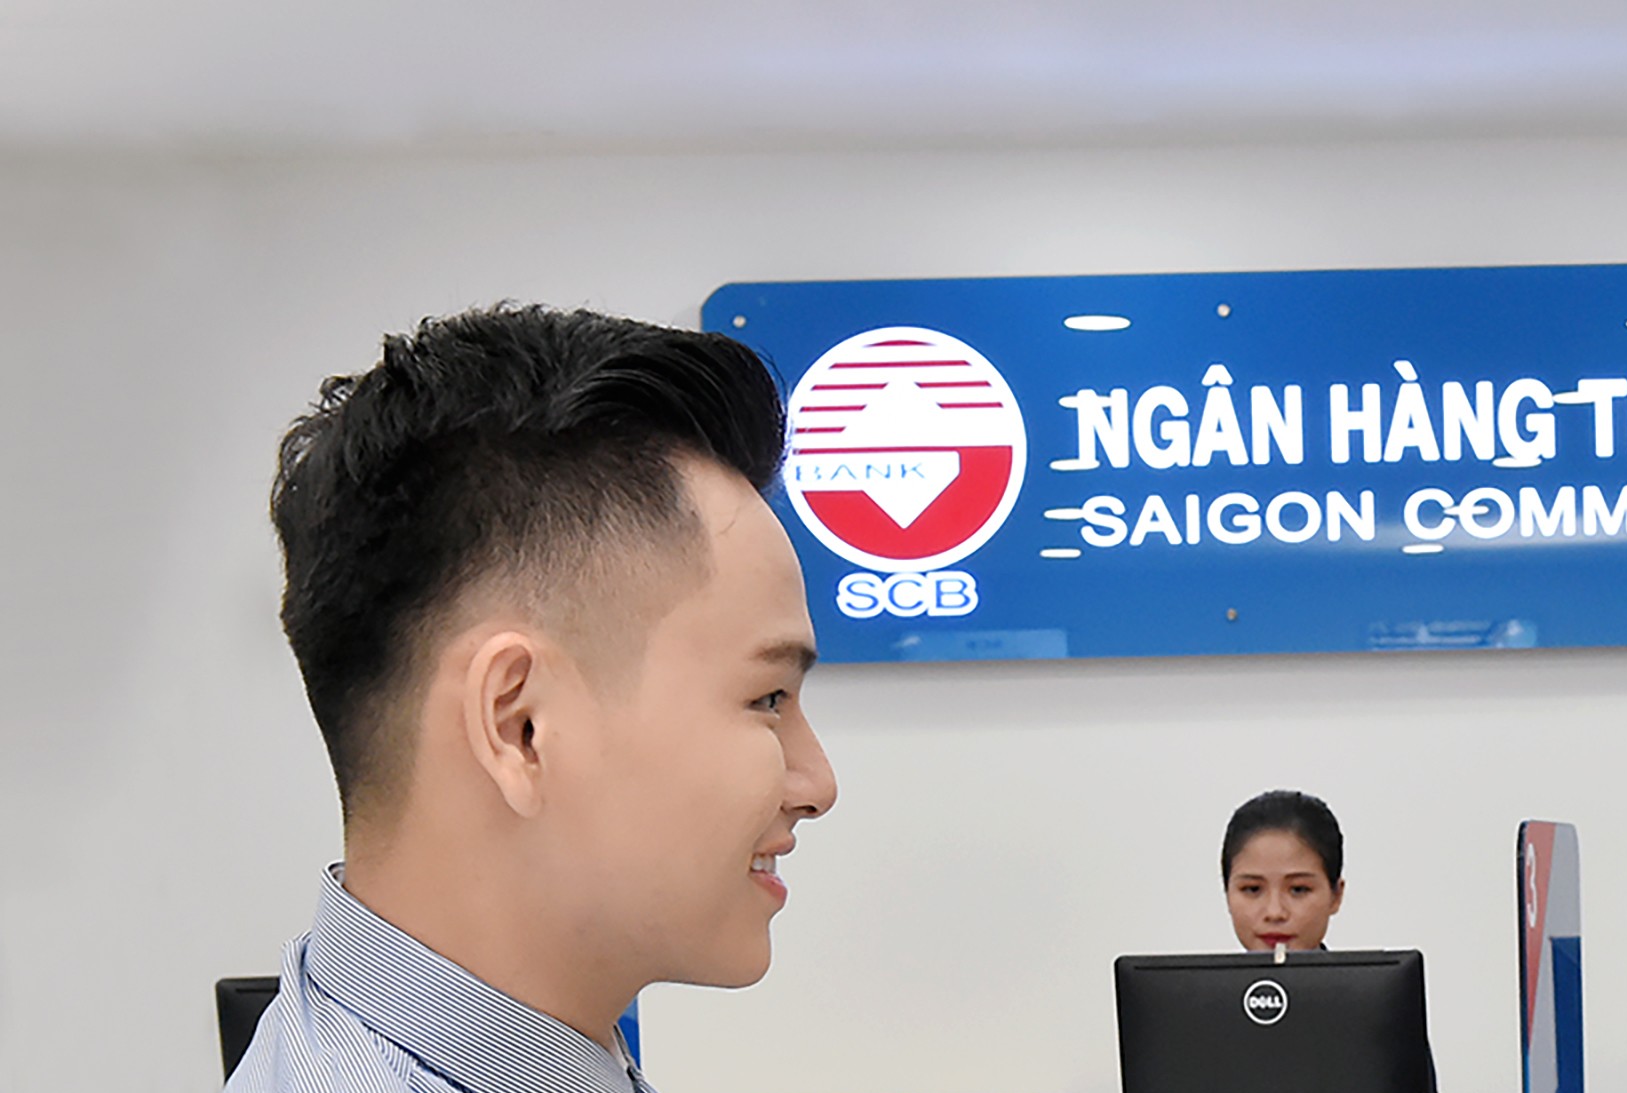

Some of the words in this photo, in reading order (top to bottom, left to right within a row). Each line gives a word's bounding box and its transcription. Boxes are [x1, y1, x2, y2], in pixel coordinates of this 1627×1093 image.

[1076, 363, 1304, 470] NGÂN
[1330, 360, 1558, 464] HÀNG
[1079, 490, 1376, 547] SAIGON
[839, 574, 977, 616] SCB
[1526, 843, 1538, 928] 3
[1249, 995, 1283, 1009] DELL
